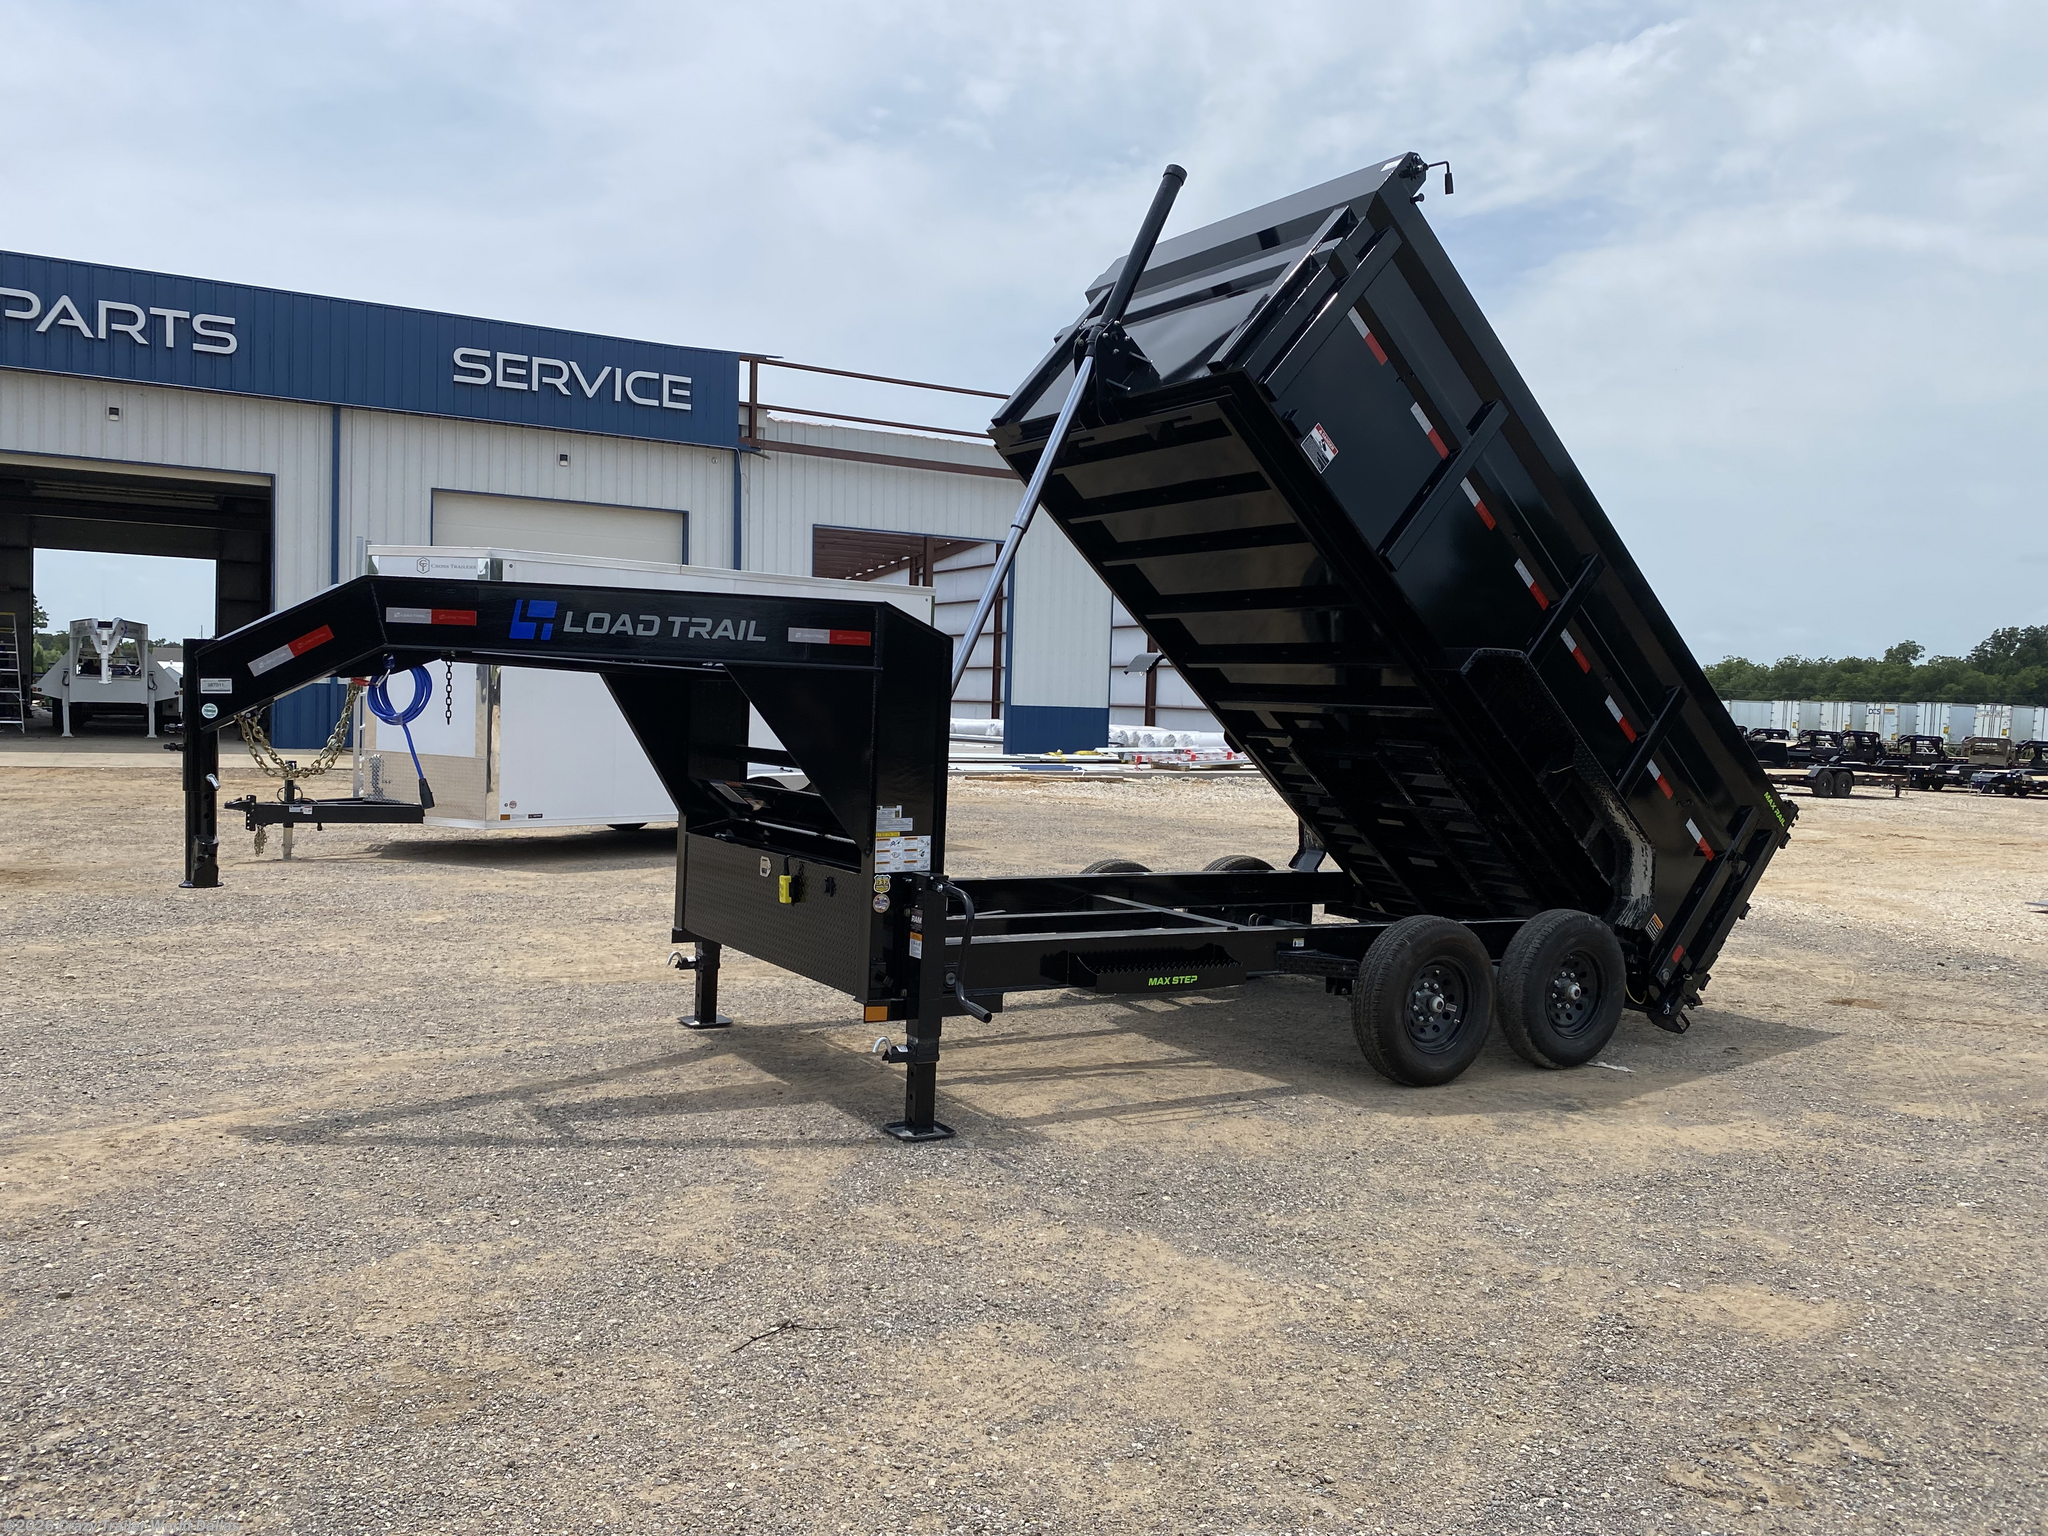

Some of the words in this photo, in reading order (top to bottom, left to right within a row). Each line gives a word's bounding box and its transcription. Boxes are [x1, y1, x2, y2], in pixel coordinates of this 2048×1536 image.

[0, 286, 238, 355] PARTS
[453, 347, 692, 411] SERVICE
[563, 611, 661, 636] LOAD
[667, 616, 767, 642] TRAIL
[1764, 792, 1776, 810] MAX
[1774, 808, 1785, 827] RAIL
[1148, 977, 1170, 986] MAX
[1172, 975, 1198, 985] STEP
